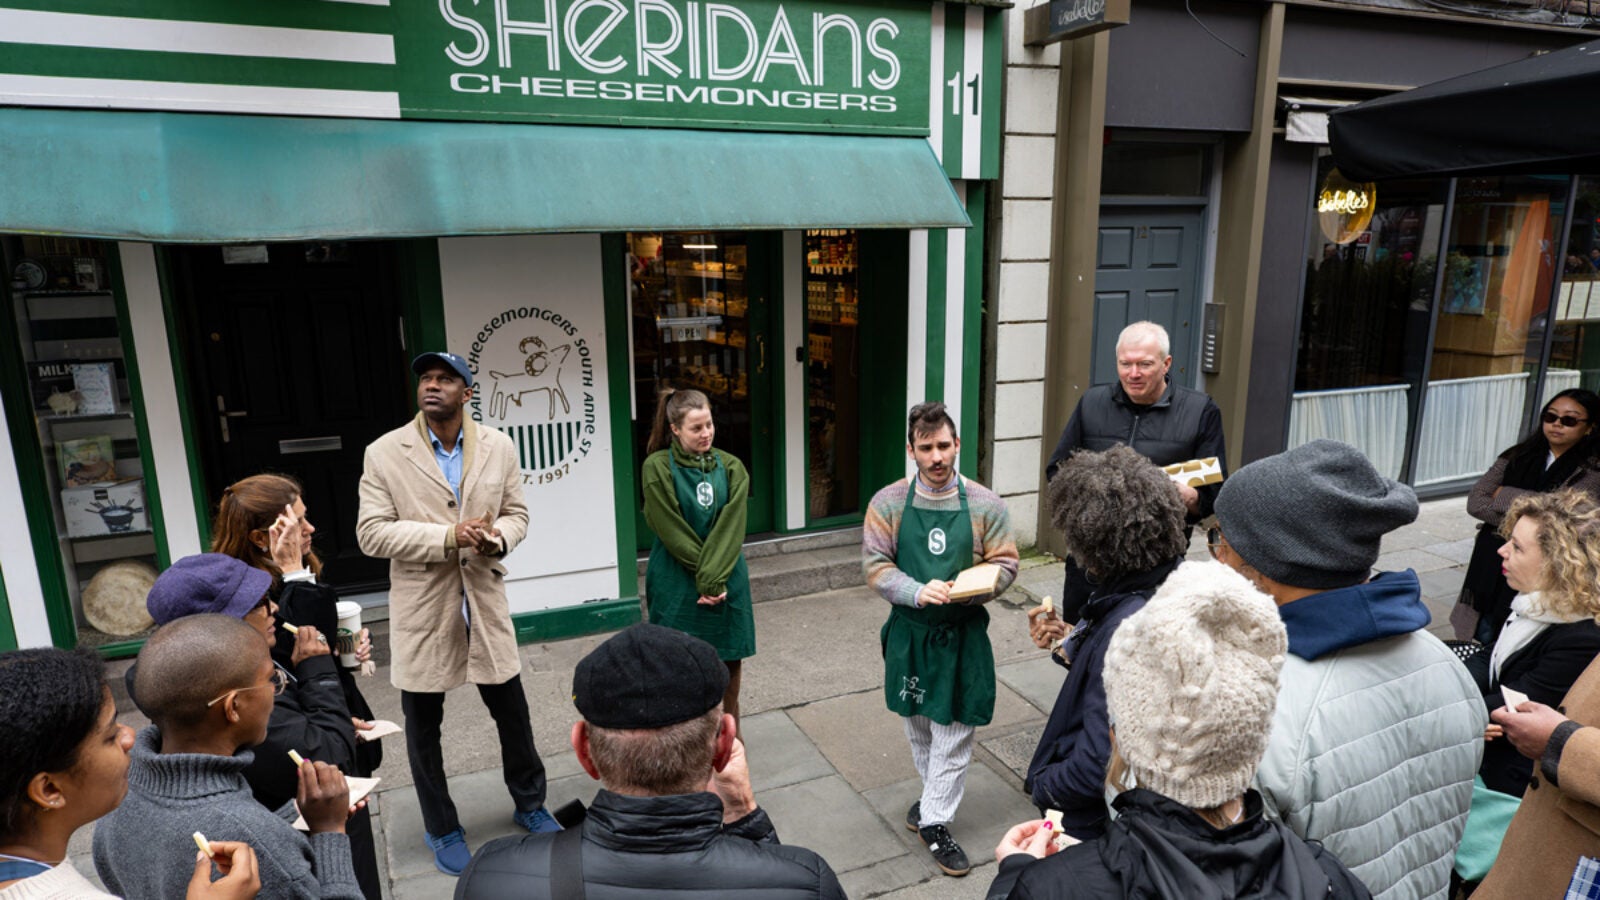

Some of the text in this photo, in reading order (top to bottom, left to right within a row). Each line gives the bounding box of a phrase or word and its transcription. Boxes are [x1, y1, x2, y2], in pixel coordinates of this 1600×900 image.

[449, 72, 898, 113] CHEESEMONGERS
[947, 70, 980, 116] 11
[678, 327, 702, 338] OPEN
[38, 364, 73, 377] MILK
[574, 338, 593, 387] SOUTH
[537, 462, 570, 485] 1997
[930, 528, 945, 554] S
